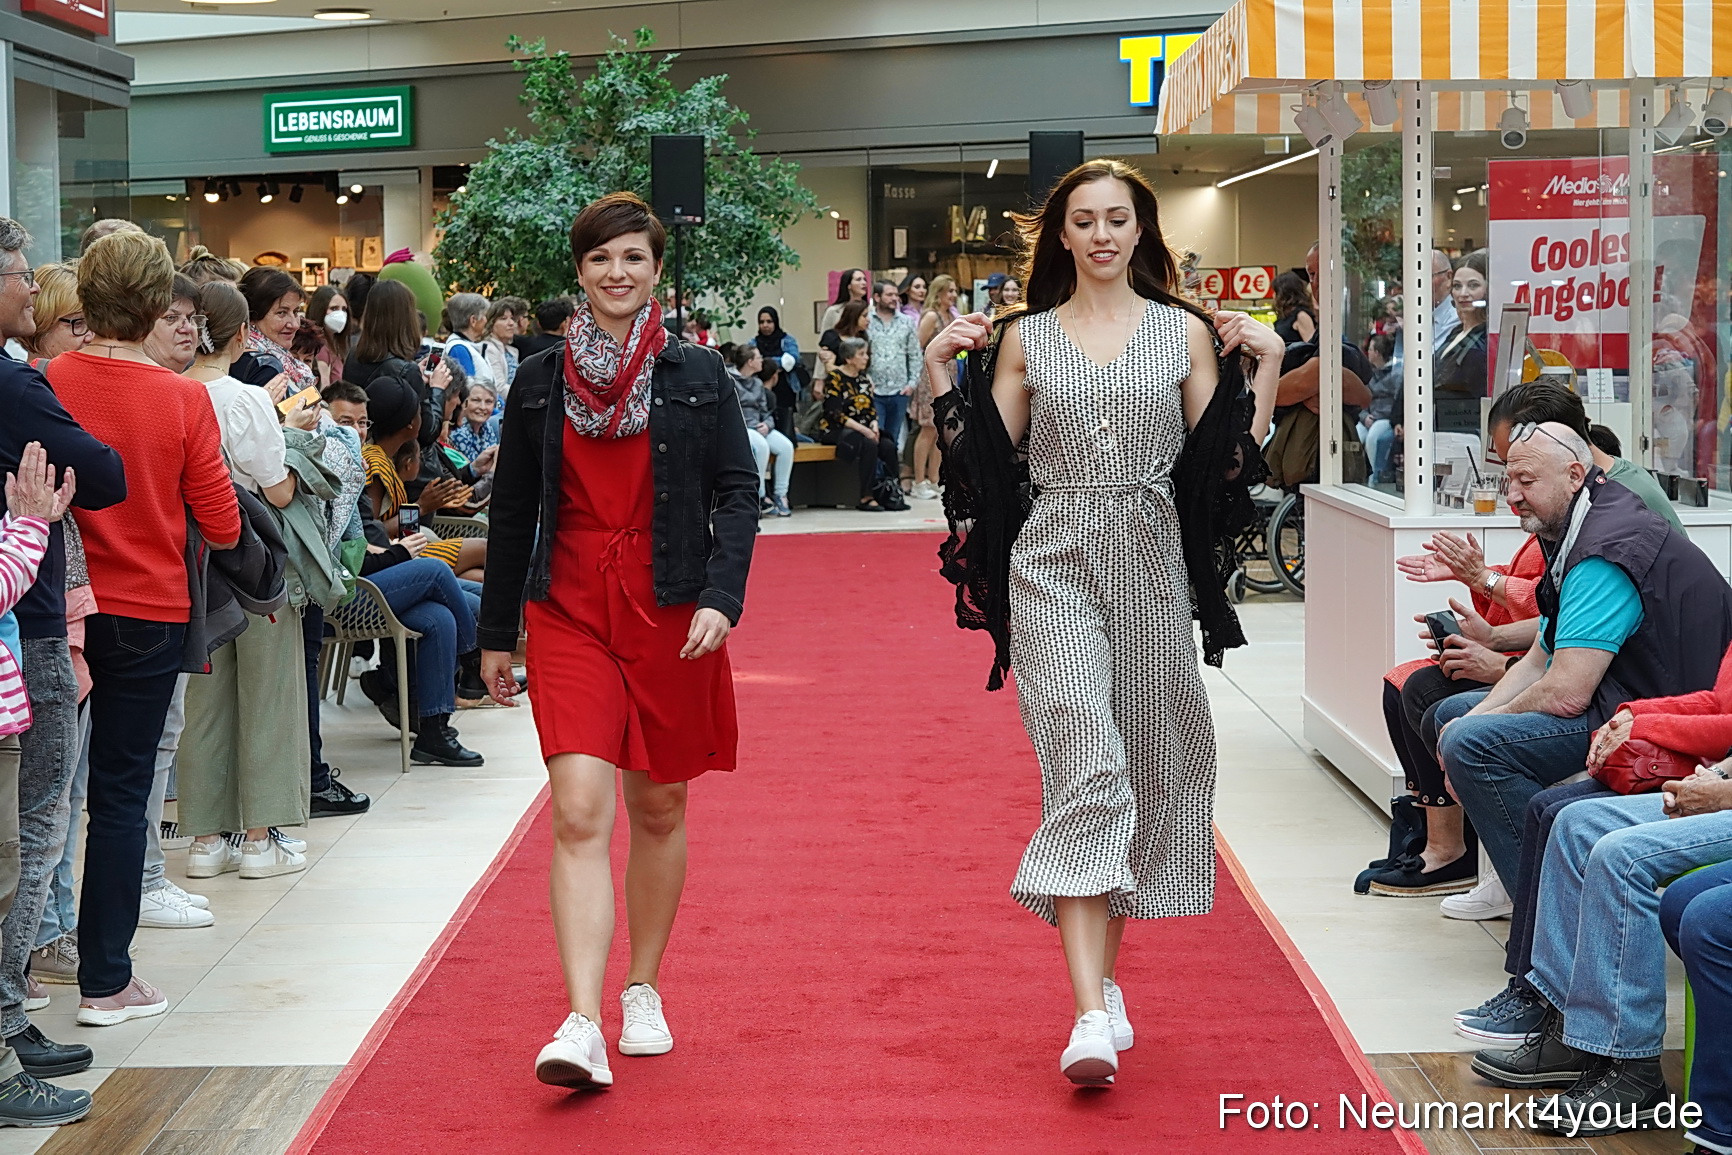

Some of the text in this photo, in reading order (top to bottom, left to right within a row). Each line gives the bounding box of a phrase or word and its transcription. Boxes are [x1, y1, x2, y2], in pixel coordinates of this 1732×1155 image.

[278, 107, 394, 132] LEBENSRAUM
[884, 183, 916, 199] Kasse
[1239, 274, 1265, 294] 2€
